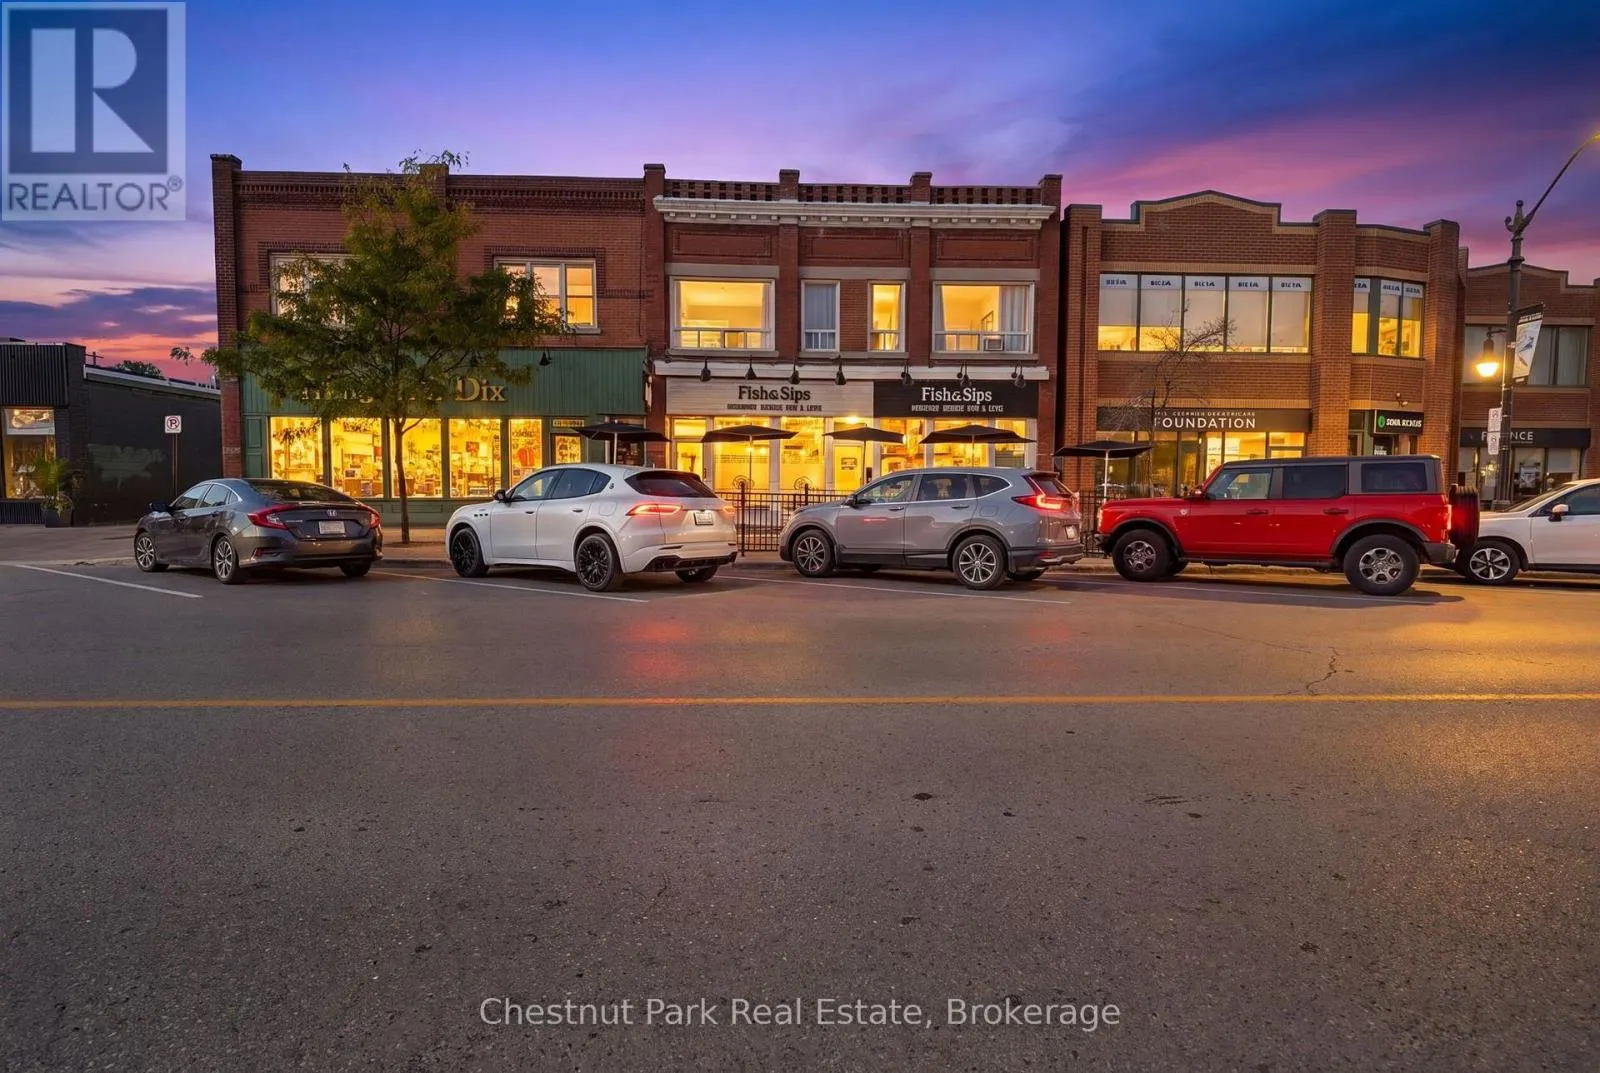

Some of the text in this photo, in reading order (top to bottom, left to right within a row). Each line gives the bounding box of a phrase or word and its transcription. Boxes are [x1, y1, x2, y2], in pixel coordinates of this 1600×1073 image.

[456, 377, 505, 402] Dix
[1153, 417, 1256, 429] FOUNDATION
[1481, 431, 1534, 441] FNCE
